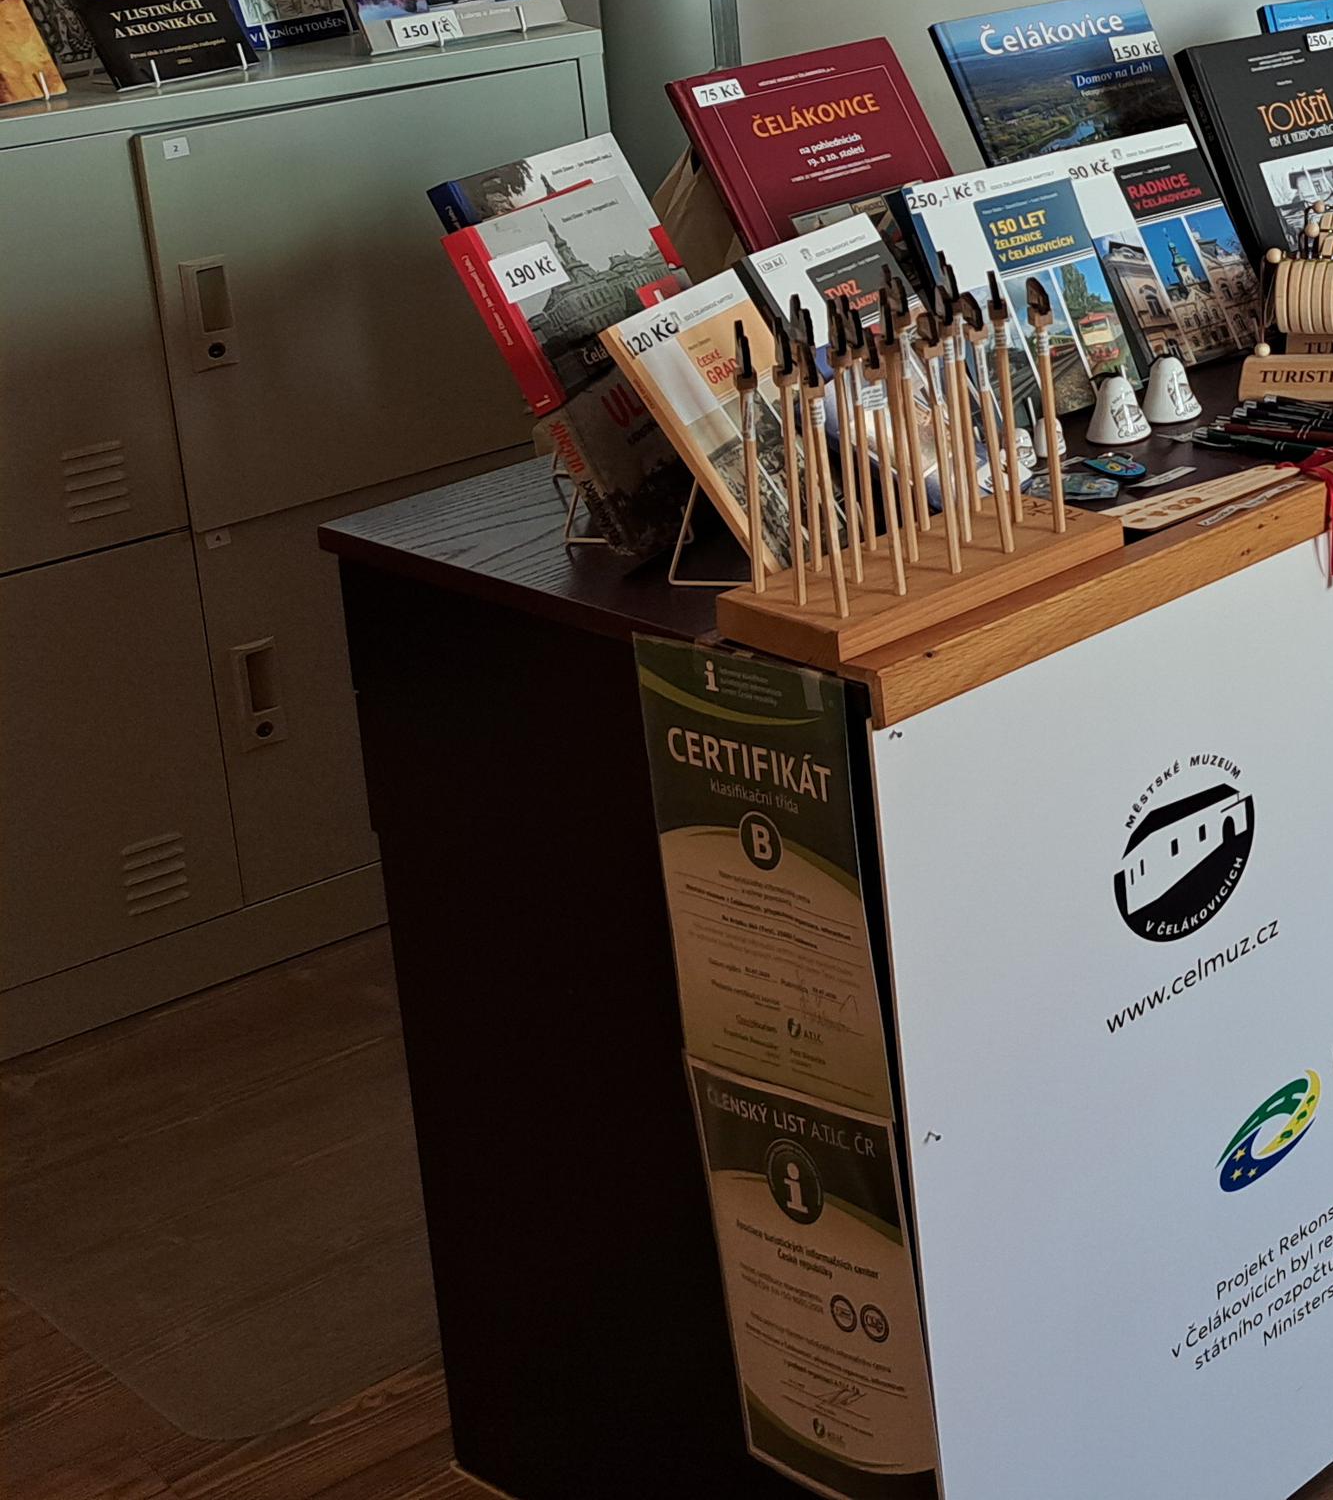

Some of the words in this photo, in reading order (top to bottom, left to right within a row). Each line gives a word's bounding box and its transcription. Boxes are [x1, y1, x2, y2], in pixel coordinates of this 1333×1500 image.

[110, 11, 123, 22] V
[114, 27, 126, 40] A
[129, 12, 218, 37] KRONIKÁCH
[402, 25, 428, 39] 150
[979, 13, 1126, 56] Čelákovice
[1113, 44, 1141, 61] 150
[1144, 39, 1161, 56] Kč
[1076, 69, 1113, 88] Domov
[1115, 67, 1128, 78] na
[1129, 62, 1153, 75] Labi
[700, 88, 719, 103] 75
[721, 84, 740, 98] Kč
[752, 93, 880, 138] ČELÁKOVICE
[800, 146, 811, 156] na
[812, 133, 862, 155] pohlednicích
[840, 145, 866, 160] století
[1068, 164, 1089, 180] 90
[1090, 157, 1114, 176] Kč
[953, 181, 973, 200] Kč
[1126, 172, 1190, 199] RADNICE
[1133, 199, 1141, 211] V
[989, 218, 1016, 237] 150
[1019, 210, 1047, 231] LET
[993, 229, 1043, 251] ŽELEZNICE
[999, 252, 1007, 263] V
[1008, 235, 1075, 261] ČELÁKOVICÍCH
[505, 263, 537, 287] 190
[538, 255, 557, 276] Kč
[824, 279, 863, 299] TVRZ
[625, 331, 653, 358] 120
[651, 319, 680, 342] Kč
[667, 727, 831, 803] CERTIFIKÁT
[710, 778, 772, 807] klasifikační
[776, 795, 799, 814] třída
[1124, 758, 1182, 831] MĚSTSKÉ
[1189, 753, 1243, 780] MUZEUM
[750, 822, 773, 861] B
[1144, 918, 1155, 935] V
[1156, 856, 1244, 936] ČELÁKOVICÍCH
[1105, 918, 1280, 1034] www.celmuz.cz
[774, 1109, 806, 1135] LIST
[854, 1132, 876, 1158] ČR
[1216, 1248, 1275, 1300] Projekt
[1171, 1342, 1181, 1359] v
[1185, 1267, 1287, 1349] Čelákovicích
[1290, 1244, 1314, 1278] byl
[1195, 1311, 1263, 1371] státního
